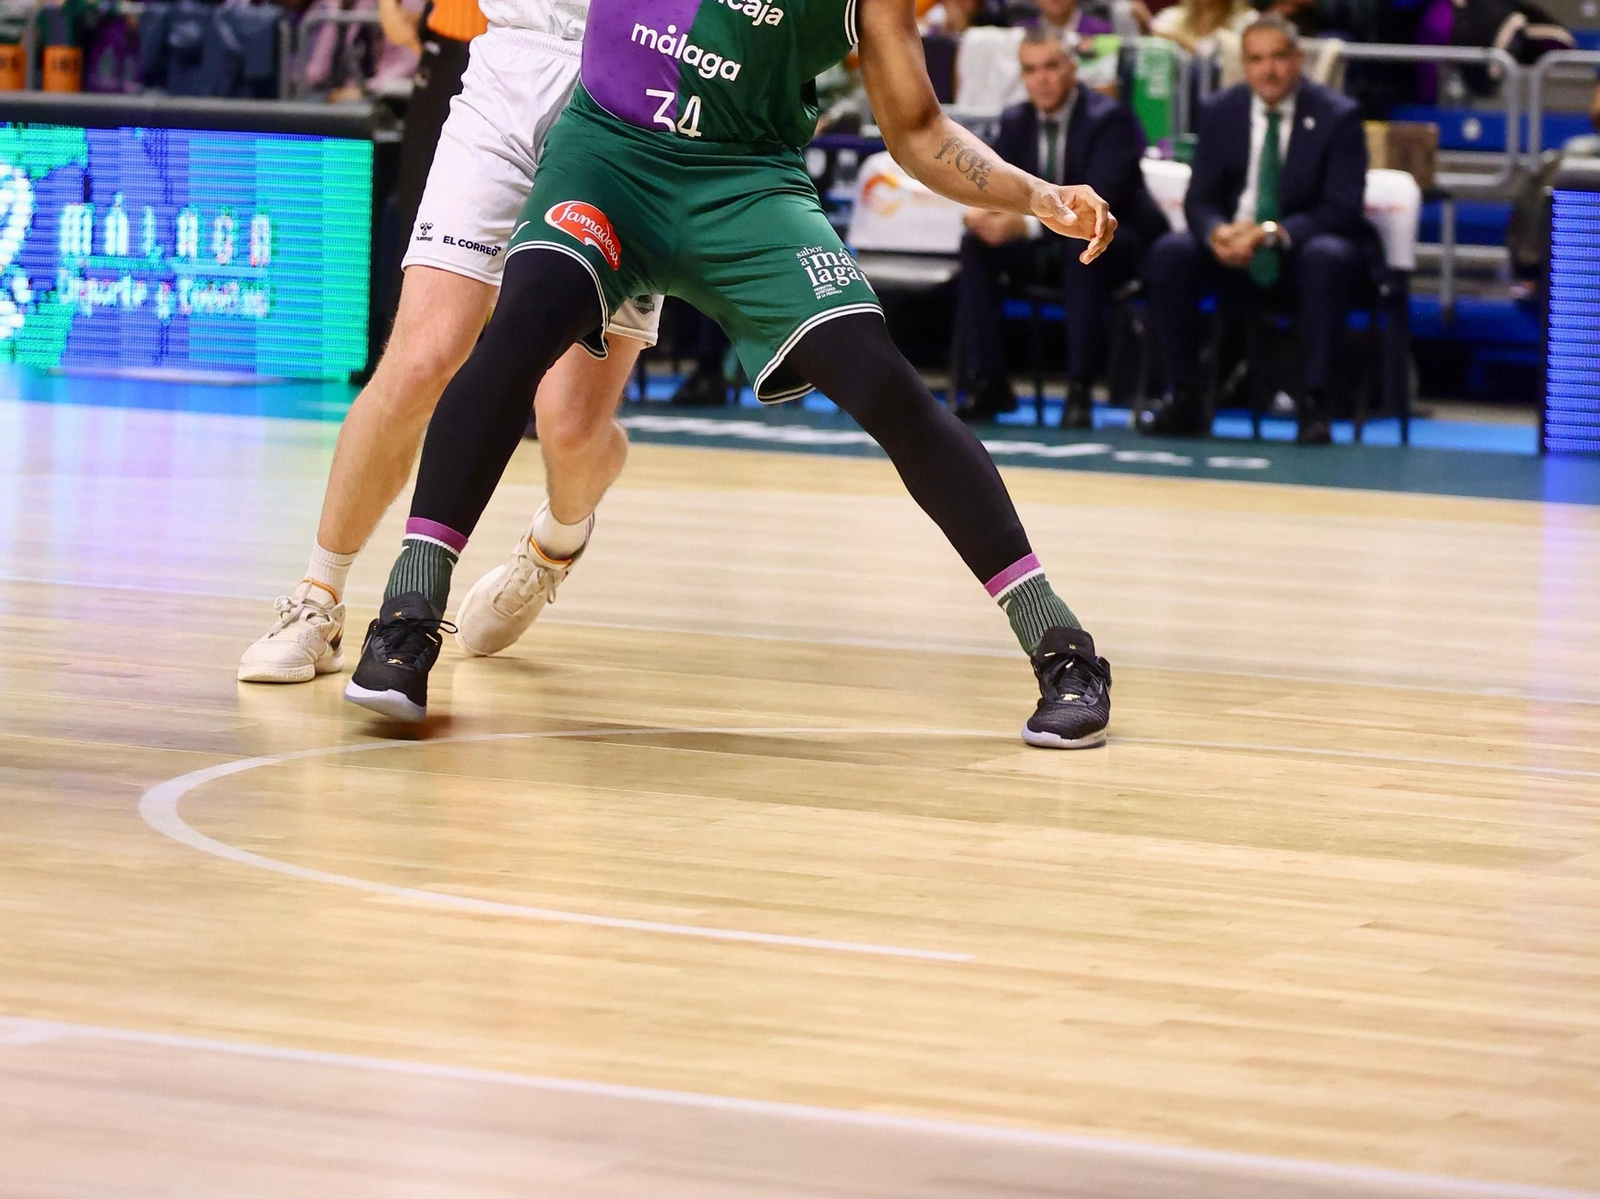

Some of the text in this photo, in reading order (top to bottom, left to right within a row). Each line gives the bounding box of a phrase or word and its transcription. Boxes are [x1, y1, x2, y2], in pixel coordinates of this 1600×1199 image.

[645, 88, 702, 138] 34
[554, 203, 619, 266] famadesa
[442, 235, 498, 257] EL CORREO
[796, 245, 823, 258] sabor
[800, 257, 810, 266] a
[804, 265, 862, 287] laga
